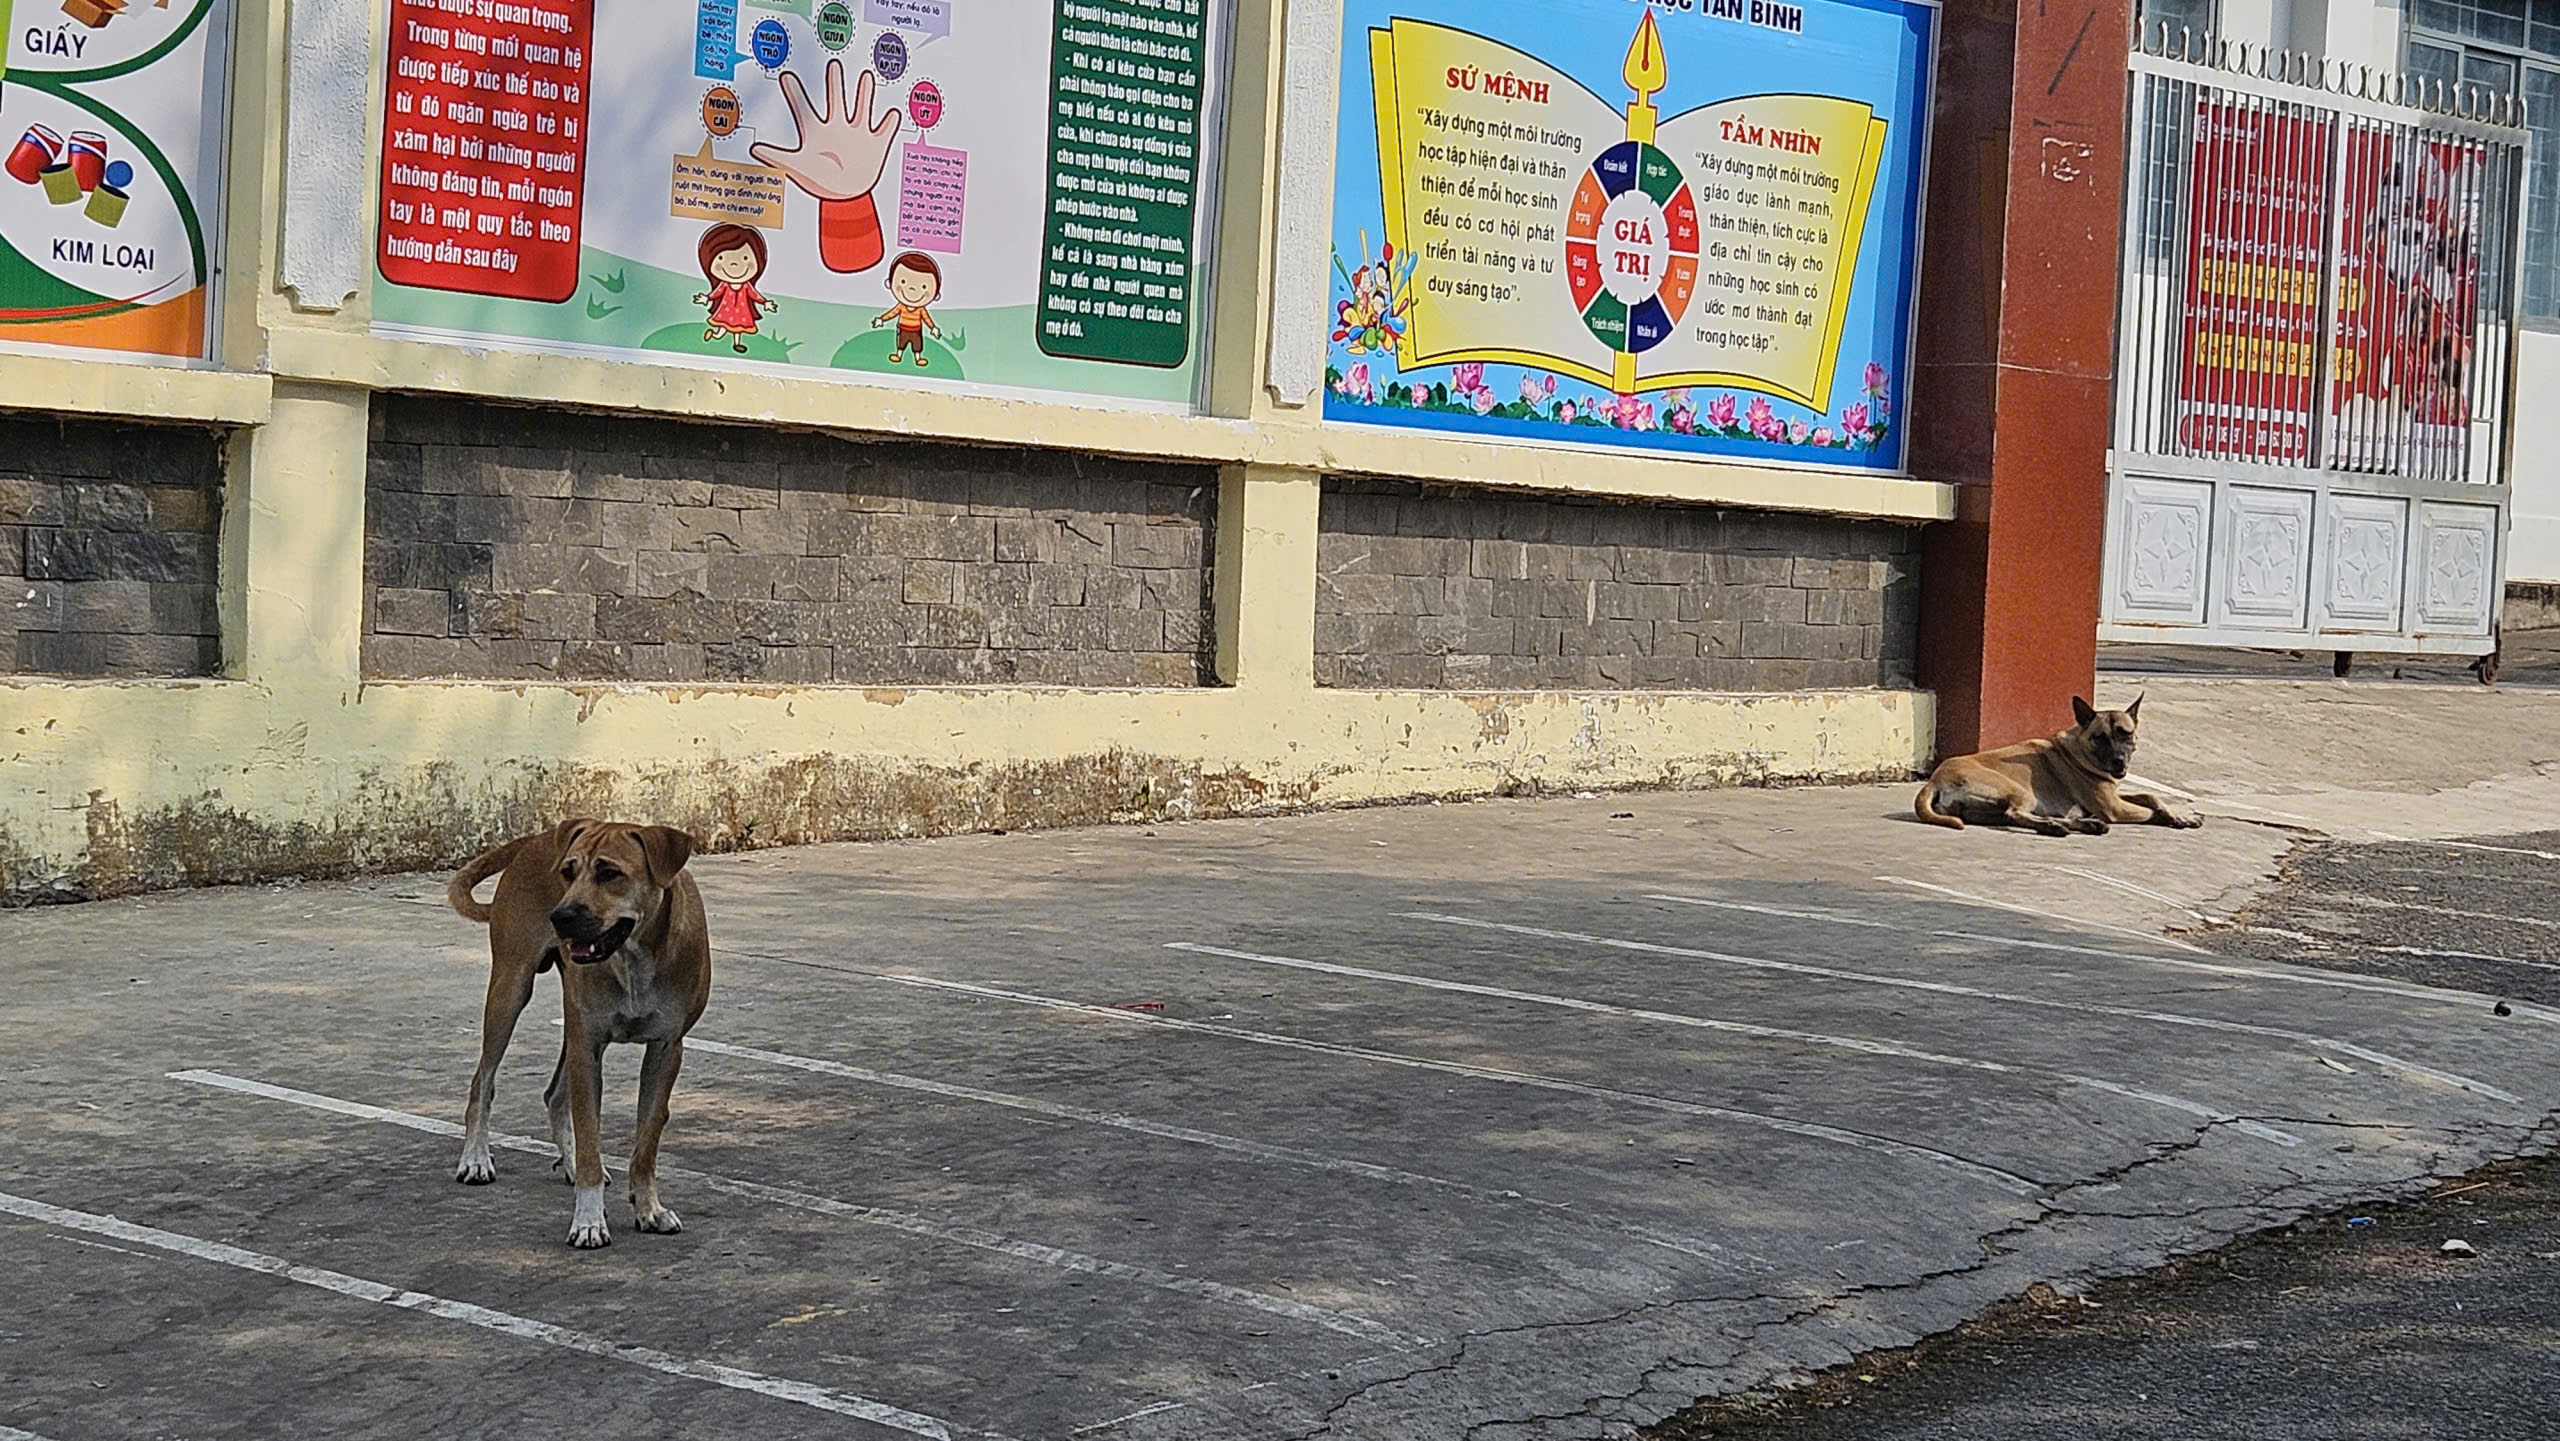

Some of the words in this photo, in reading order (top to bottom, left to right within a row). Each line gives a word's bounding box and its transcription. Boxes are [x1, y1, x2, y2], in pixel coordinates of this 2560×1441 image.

[496, 3, 529, 24] quan
[532, 8, 572, 33] trọng.
[25, 23, 88, 59] GIẤY
[407, 20, 449, 49] Trong
[455, 29, 486, 56] từng
[492, 35, 519, 58] mối
[525, 43, 559, 65] quan
[565, 49, 581, 73] hệ
[399, 56, 436, 84] được
[441, 60, 469, 87] tiếp
[474, 68, 500, 91] xúc
[505, 72, 528, 95] thế
[533, 78, 558, 100] nào
[563, 82, 579, 104] và
[1446, 63, 1479, 91] SỨ
[1484, 71, 1550, 105] MỆNH
[396, 91, 411, 113] từ
[421, 95, 439, 117] đó
[448, 101, 484, 124] ngăn
[492, 109, 528, 131] ngừa
[536, 112, 555, 134] trẻ
[564, 117, 578, 143] bị
[1452, 114, 1484, 138] dựng
[1488, 120, 1511, 139] một
[1515, 124, 1537, 142] môi
[1541, 128, 1581, 153] trường
[1720, 114, 1764, 146] TẦM
[1769, 128, 1822, 156] NHÌN
[394, 128, 428, 151] xâm
[433, 133, 455, 160] hại
[461, 136, 483, 160] bởi
[488, 144, 532, 170] những
[536, 152, 575, 173] người
[1419, 142, 1443, 161] học
[1446, 146, 1466, 165] tập
[1469, 152, 1496, 169] hiện
[1500, 154, 1519, 176] đại
[1522, 159, 1536, 174] và
[1539, 161, 1566, 179] thân
[392, 163, 438, 191] không
[442, 171, 477, 197] đáng
[508, 178, 534, 203] mỗi
[539, 187, 572, 208] ngón
[1421, 176, 1454, 196] thiện
[1458, 177, 1474, 198] để
[1478, 182, 1501, 201] mỗi
[1505, 187, 1528, 207] học
[1531, 192, 1557, 210] sinh
[1725, 157, 1753, 180] dựng
[1756, 163, 1777, 182] một
[1780, 168, 1800, 184] môi
[1803, 170, 1839, 193] trường
[1703, 184, 1729, 203] giáo
[1737, 188, 1758, 207] dục
[1766, 192, 1790, 211] lành
[1798, 200, 1833, 220] mạnh,
[390, 199, 413, 223] tay
[420, 202, 435, 225] là
[477, 214, 503, 236] quy
[510, 212, 532, 237] tắc
[540, 219, 570, 242] theo
[1423, 207, 1448, 227] đều
[1455, 213, 1471, 231] có
[1478, 217, 1494, 233] cơ
[1500, 219, 1520, 238] hội
[1527, 223, 1554, 242] phát
[1614, 217, 1653, 245] GIÁ
[1710, 213, 1734, 230] thân
[1738, 215, 1769, 239] thiện,
[1773, 222, 1793, 241] tích
[1796, 227, 1815, 246] cực
[1819, 227, 1828, 245] là
[53, 238, 94, 264] KIM
[103, 243, 154, 274] LOẠI
[388, 234, 432, 263] hướng
[435, 239, 460, 264] dẫn
[464, 248, 489, 267] sau
[492, 251, 518, 273] đây
[1426, 239, 1456, 261] triển
[1462, 246, 1478, 264] tài
[1484, 250, 1515, 273] năng
[1521, 255, 1535, 272] và
[1541, 257, 1554, 273] tư
[1614, 251, 1650, 282] TRỊ
[1710, 241, 1727, 262] địa
[1734, 243, 1751, 262] chỉ
[1757, 247, 1771, 265] tin
[1777, 251, 1796, 272] cậy
[1802, 254, 1823, 271] cho
[1428, 276, 1453, 297] duy
[1456, 279, 1487, 301] sáng
[1708, 271, 1744, 293] những
[1750, 275, 1770, 293] học
[1776, 279, 1799, 297] sinh
[1804, 282, 1817, 299] có
[1704, 299, 1725, 316] ước
[1732, 303, 1750, 319] mơ
[1757, 306, 1787, 324] thành
[1795, 309, 1812, 329] đạt
[1696, 327, 1726, 348] trong
[1729, 330, 1749, 350] học
